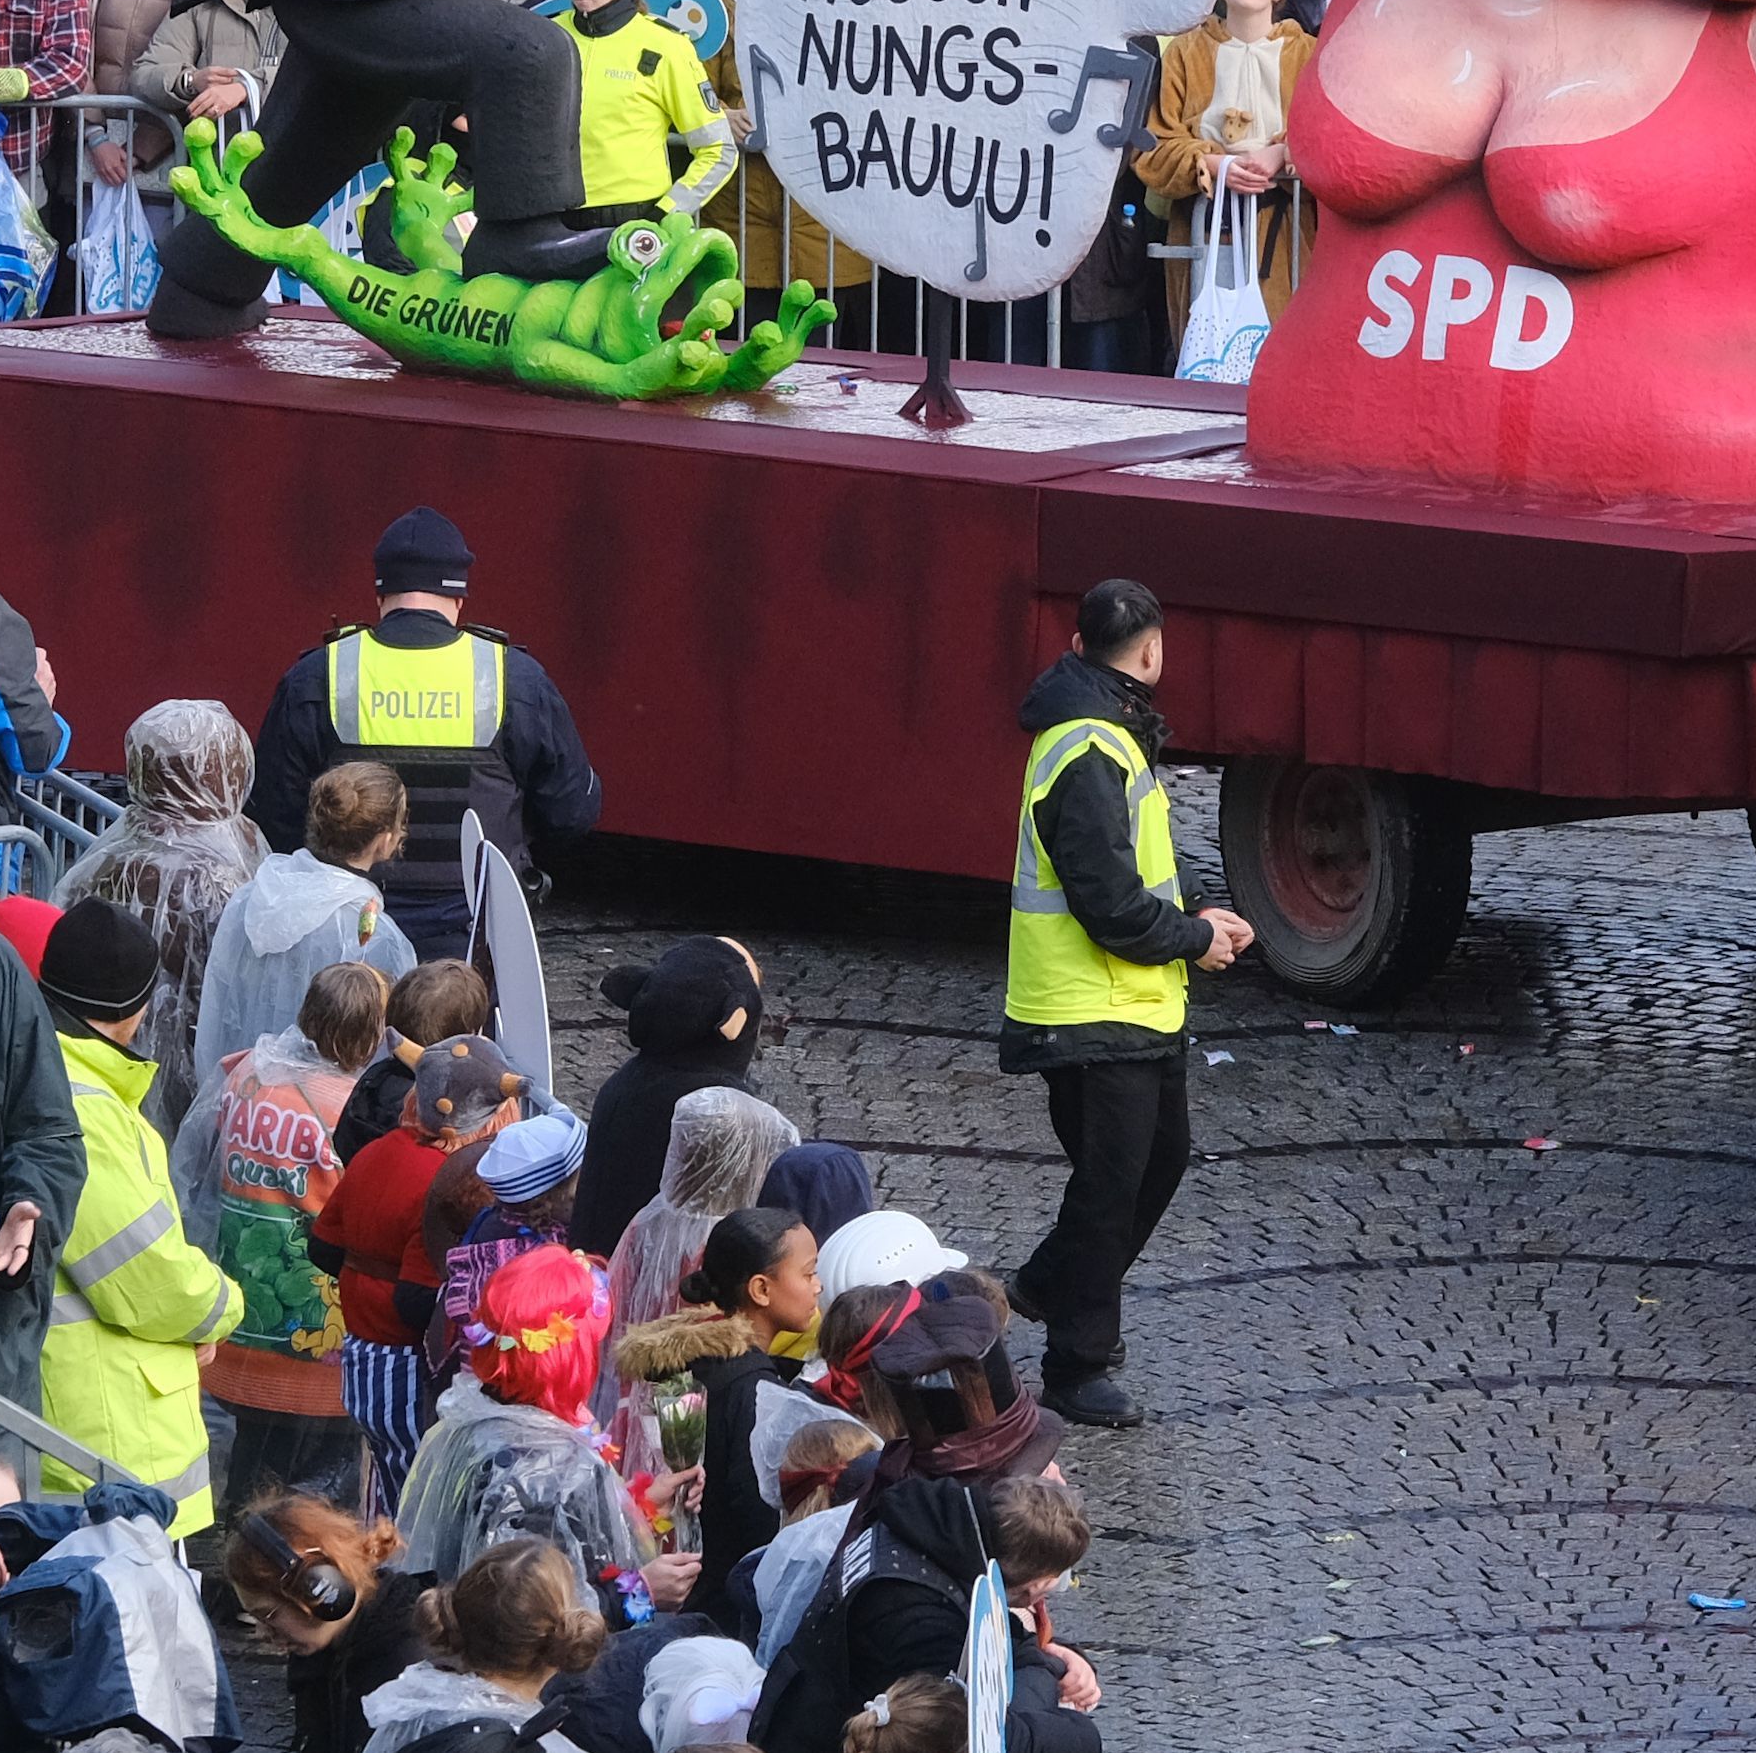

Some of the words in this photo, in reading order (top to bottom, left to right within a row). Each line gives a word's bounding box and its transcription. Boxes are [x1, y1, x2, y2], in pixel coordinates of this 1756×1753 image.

[604, 68, 637, 80] POLIZEI
[796, 12, 1059, 106] NUNGS-
[810, 107, 1056, 249] BAUUU!
[346, 274, 398, 318] DIE
[399, 293, 517, 347] GRÜNEN
[1357, 249, 1574, 372] SPD
[370, 690, 462, 719] POLIZEI
